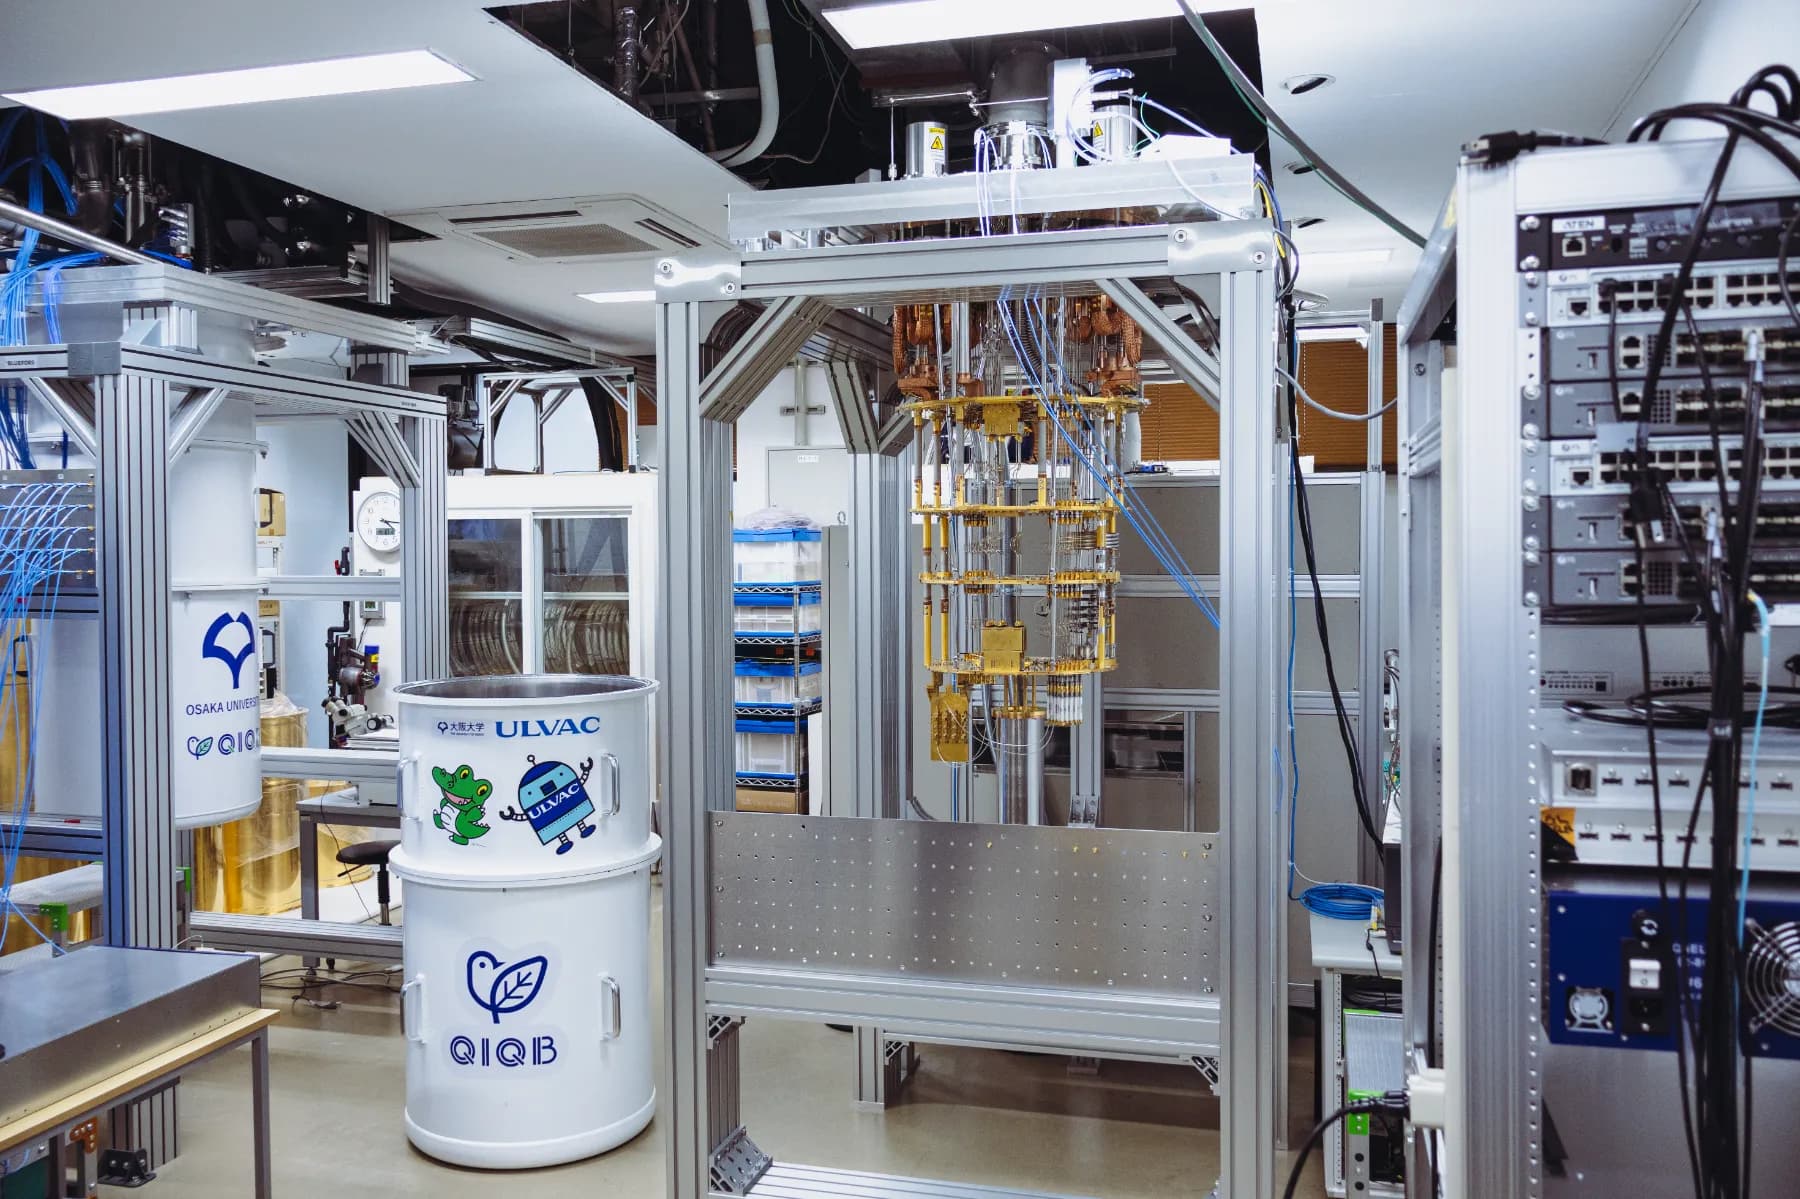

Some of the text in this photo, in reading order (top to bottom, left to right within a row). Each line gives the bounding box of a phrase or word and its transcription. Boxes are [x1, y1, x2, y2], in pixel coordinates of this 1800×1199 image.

[186, 702, 224, 716] OSAKA
[450, 721, 485, 732] 大阪大学
[495, 716, 601, 738] ULVAC
[527, 782, 580, 819] ULVAC
[450, 1035, 558, 1067] QIQB
